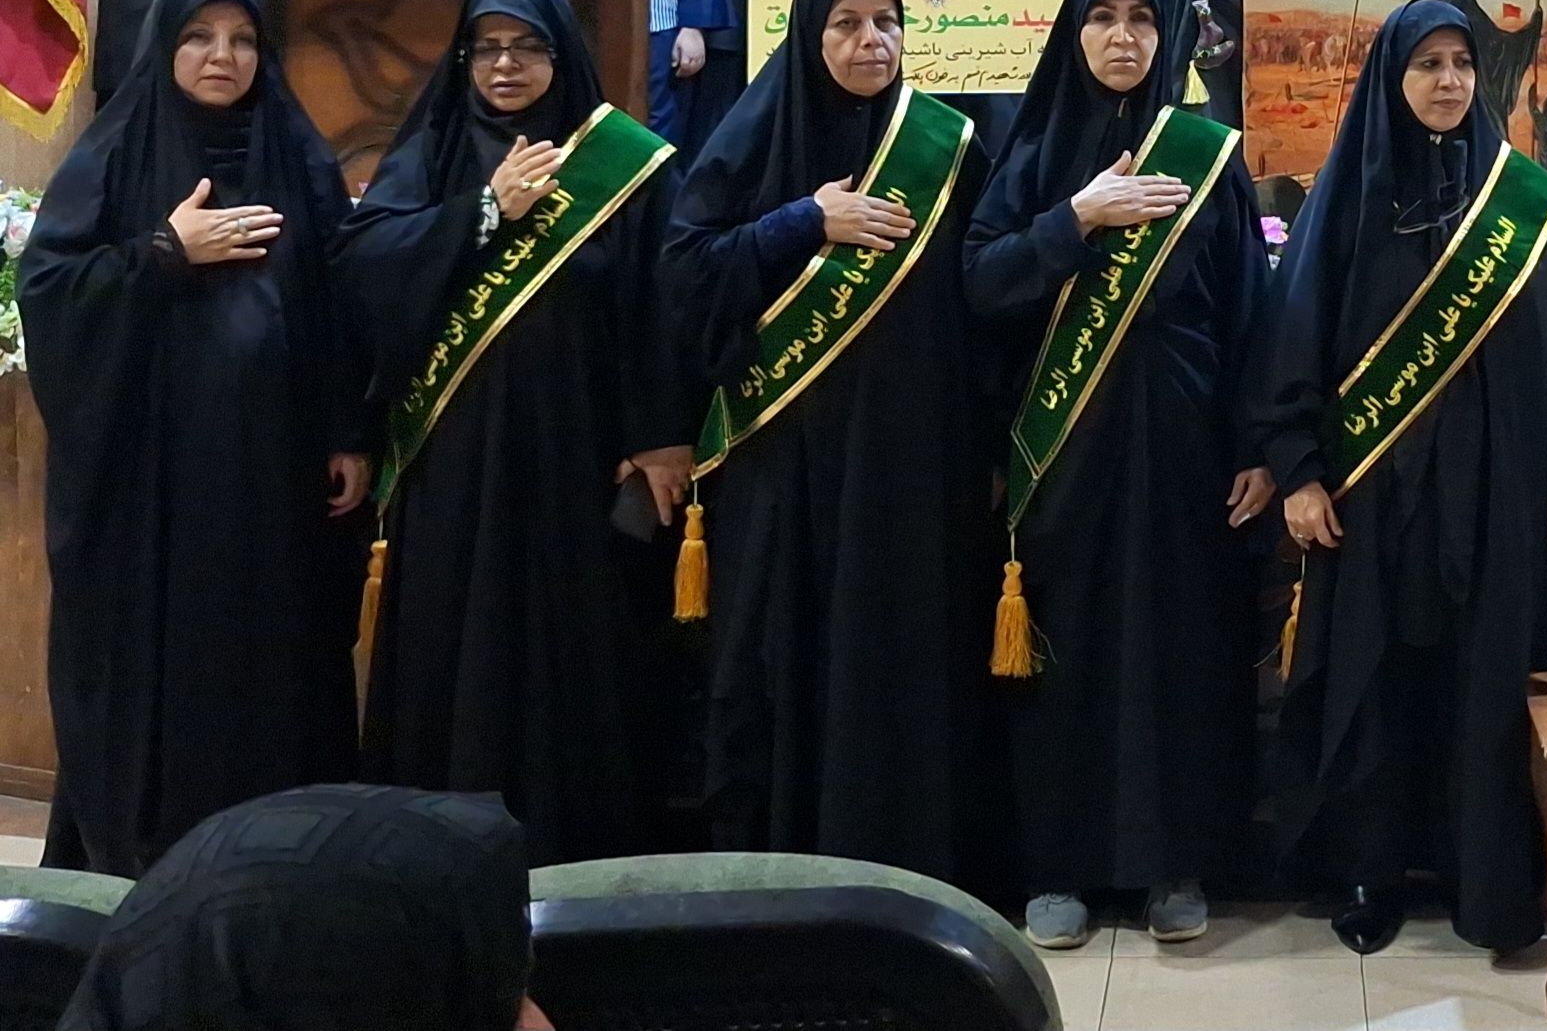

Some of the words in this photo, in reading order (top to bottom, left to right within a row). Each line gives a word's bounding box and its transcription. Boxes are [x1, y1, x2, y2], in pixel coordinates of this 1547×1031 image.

[503, 234, 537, 271] علیک
[1110, 249, 1138, 266] یا
[1486, 215, 1517, 264] السلام
[484, 271, 511, 285] یا
[843, 269, 870, 285] یا
[1100, 264, 1124, 302] علی
[1467, 255, 1496, 295] علیک
[468, 284, 492, 320] علی
[830, 282, 854, 320] علی
[1088, 296, 1107, 330] ابن
[1452, 292, 1477, 309] یا
[446, 311, 468, 346] ابن
[803, 309, 828, 344] ابن
[1438, 305, 1461, 342] علی
[423, 342, 449, 387] موسی
[770, 338, 806, 381] موسی
[1067, 326, 1093, 375] موسی
[1417, 332, 1440, 367] ابن
[1040, 367, 1070, 411] الرضا
[1384, 361, 1419, 406] موسی
[1344, 395, 1384, 437] الرضا
